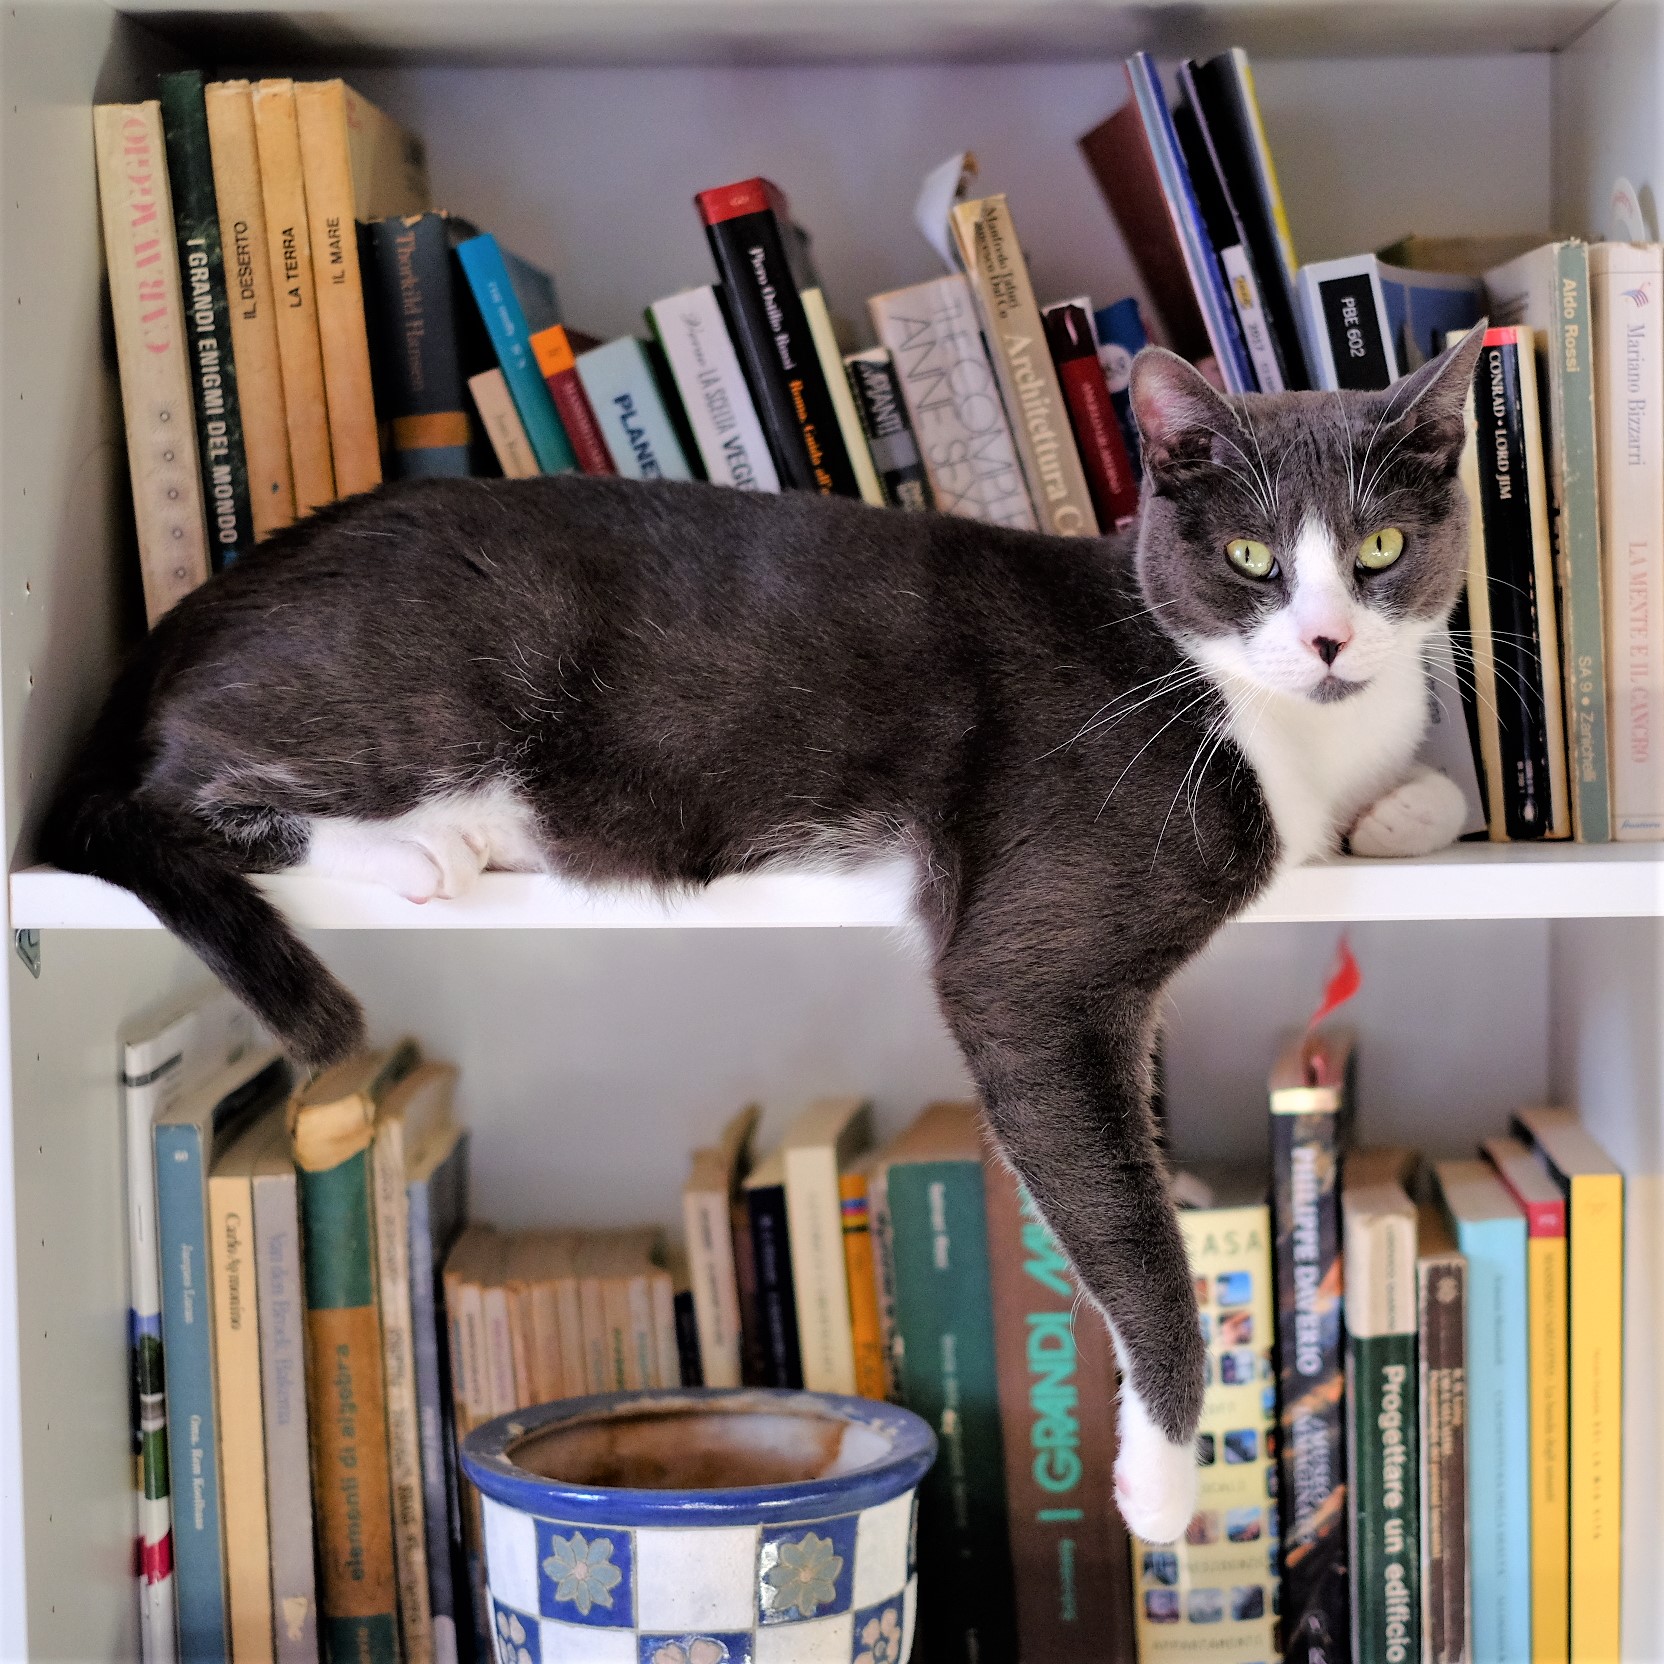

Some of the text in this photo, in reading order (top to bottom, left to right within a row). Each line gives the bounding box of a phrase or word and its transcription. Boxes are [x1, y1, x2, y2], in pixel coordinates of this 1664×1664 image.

[122, 117, 171, 353] CARAVAGGIO
[233, 220, 257, 320] IL DESERTO
[281, 226, 303, 308] LA TERRA
[326, 216, 345, 285] IL MARE
[1340, 296, 1366, 358] PBE 602
[1562, 278, 1580, 373] Aldo Rossi
[187, 237, 238, 544] I GRANDI ENIGMI DEL MONDO
[1003, 334, 1069, 503] Architettura
[1489, 351, 1513, 500] CONRAD LORD JIM
[1626, 324, 1647, 467] Mariano Bizzarri
[1629, 541, 1648, 566] LA
[1629, 568, 1649, 641] MENTE
[1630, 644, 1648, 657] E
[1577, 655, 1592, 679] SA
[1630, 685, 1650, 764] CANCRO
[1291, 1146, 1323, 1377] PHILIPPE DAVERIO
[1026, 1311, 1084, 1493] GRANDI
[1378, 1364, 1407, 1510] Progettare
[1384, 1517, 1405, 1556] un
[1384, 1561, 1412, 1664] edificio
